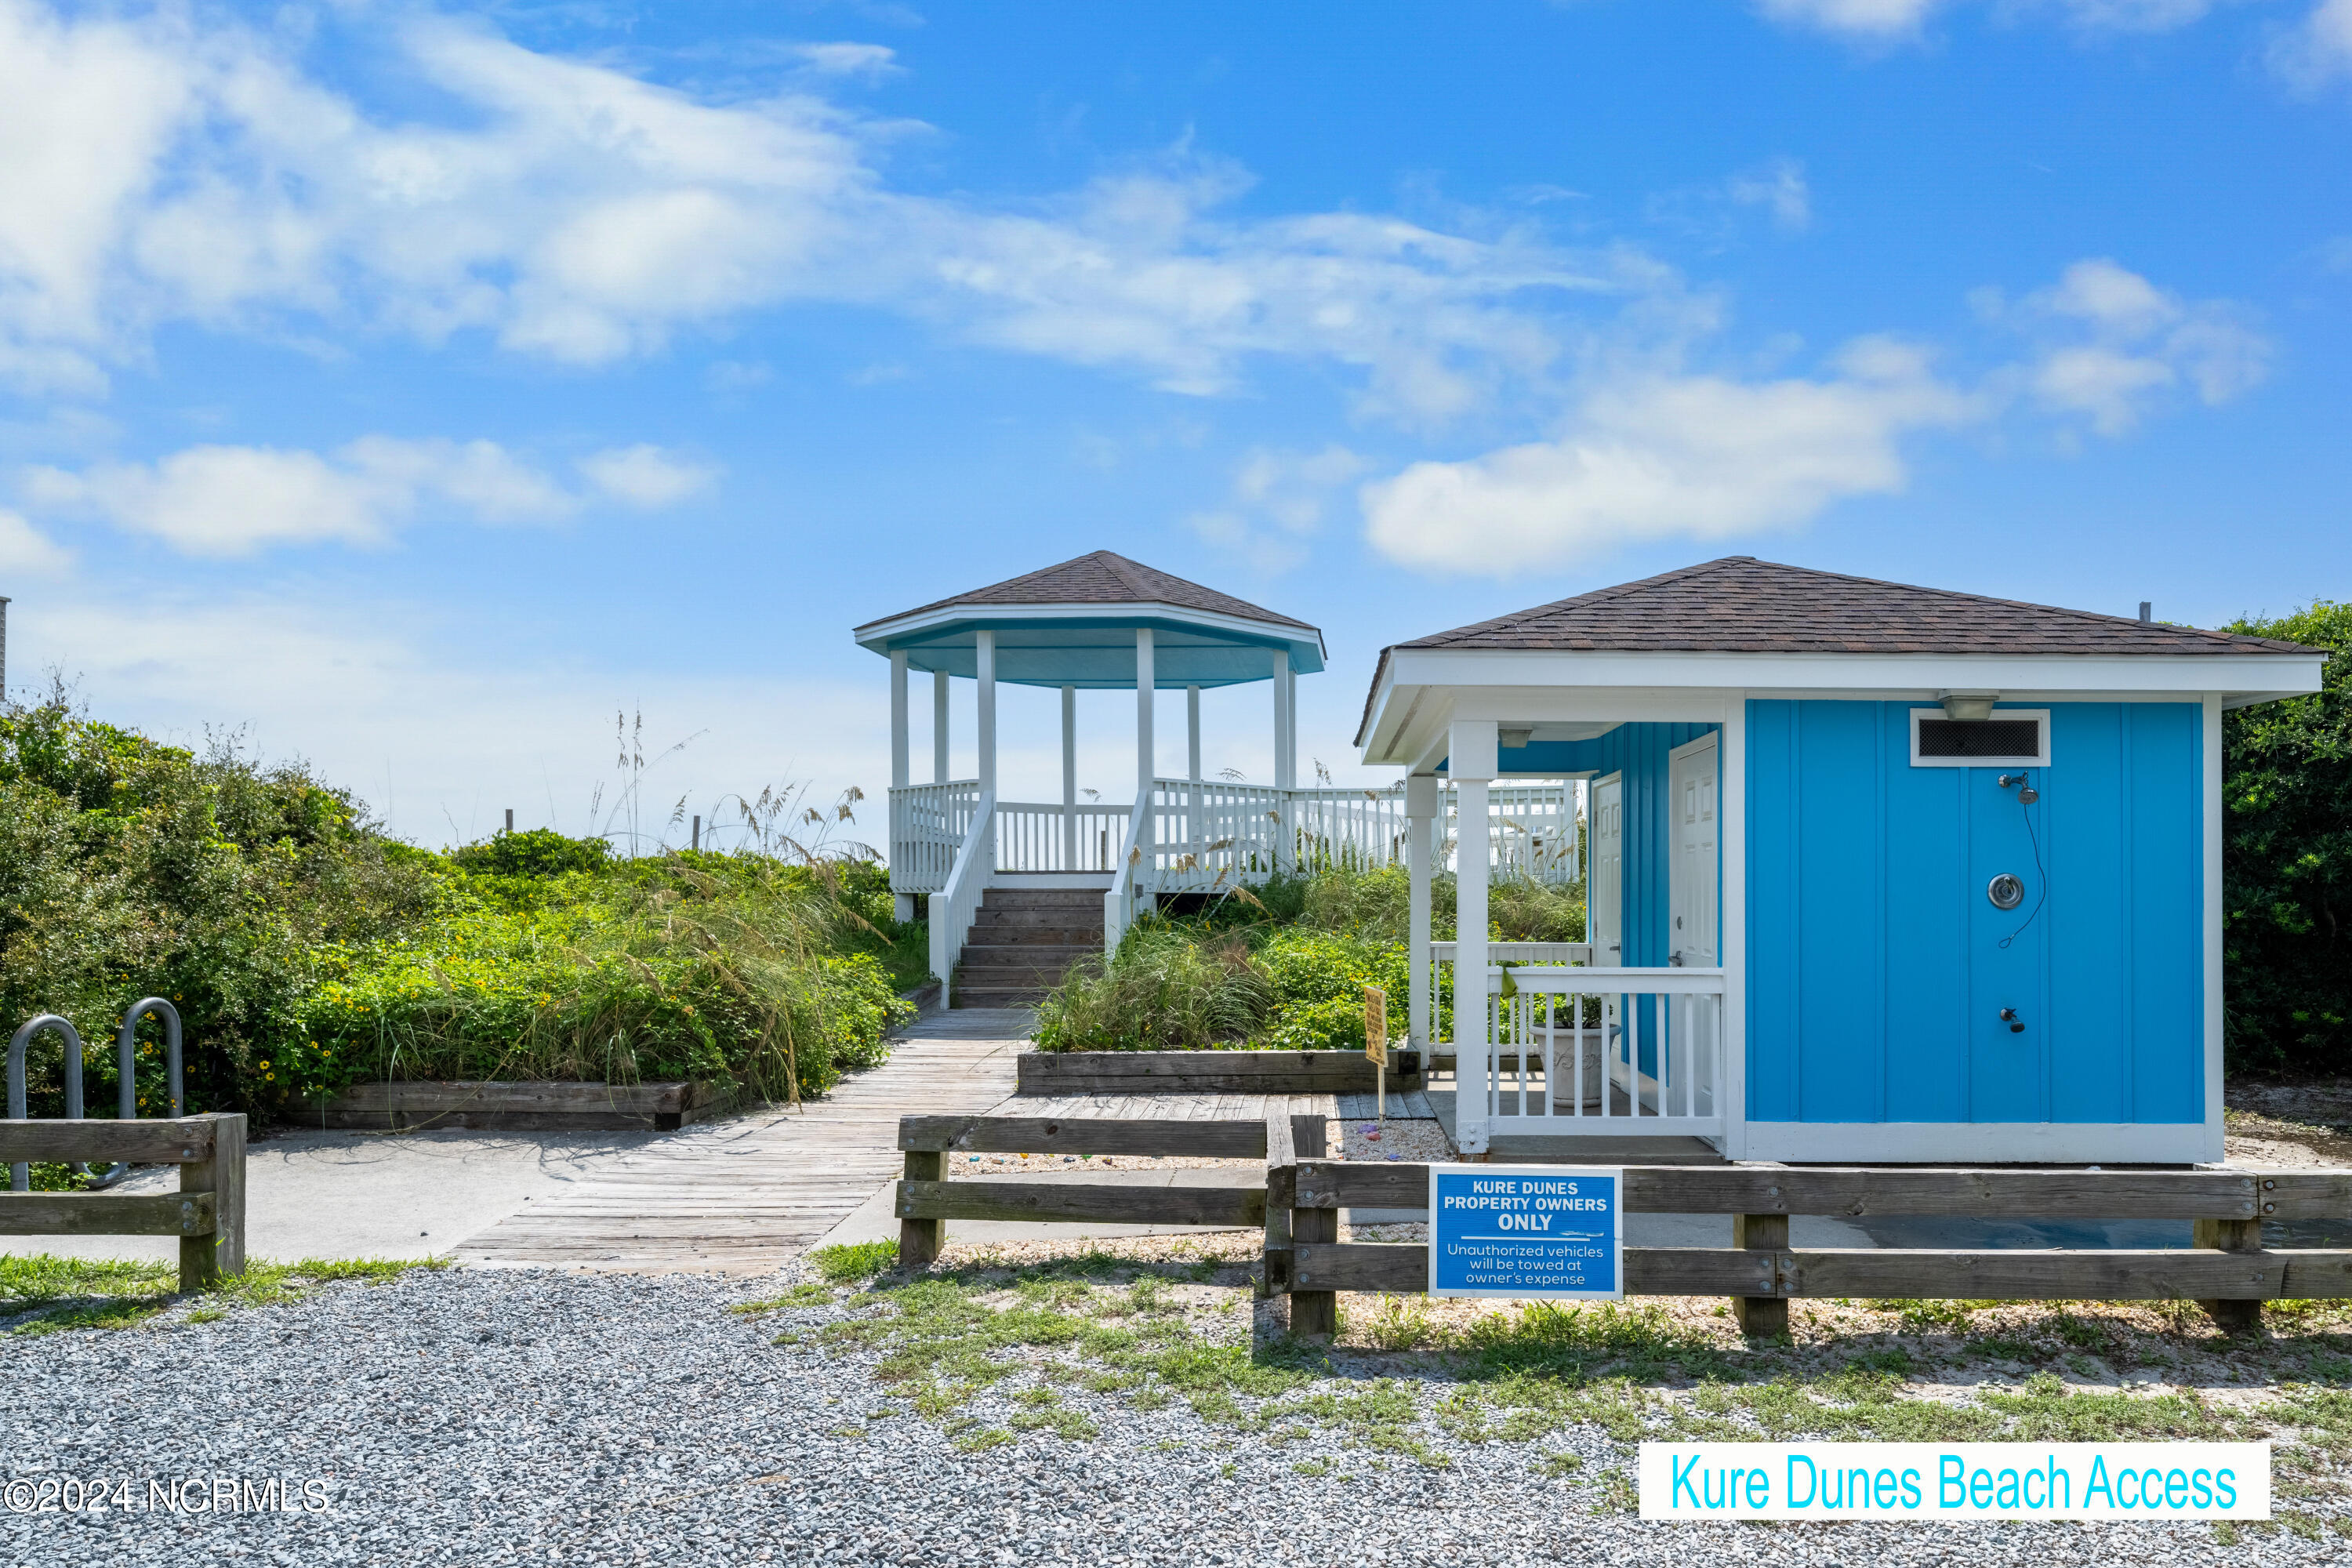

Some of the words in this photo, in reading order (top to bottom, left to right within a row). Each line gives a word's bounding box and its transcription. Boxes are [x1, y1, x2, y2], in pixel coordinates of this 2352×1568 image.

[1472, 1181, 1516, 1194] KURE
[1522, 1181, 1578, 1195] DUNES
[1444, 1196, 1530, 1210] PROPERTY
[1535, 1198, 1607, 1211] OWNERS
[1497, 1214, 1553, 1231] ONLY
[1447, 1243, 1544, 1257] Unauthorized
[1547, 1245, 1604, 1258] vehicles
[1469, 1259, 1493, 1270] will
[1497, 1258, 1514, 1270] be
[1518, 1259, 1563, 1271] towed
[1566, 1260, 1581, 1271] at
[1525, 1273, 1585, 1287] expense
